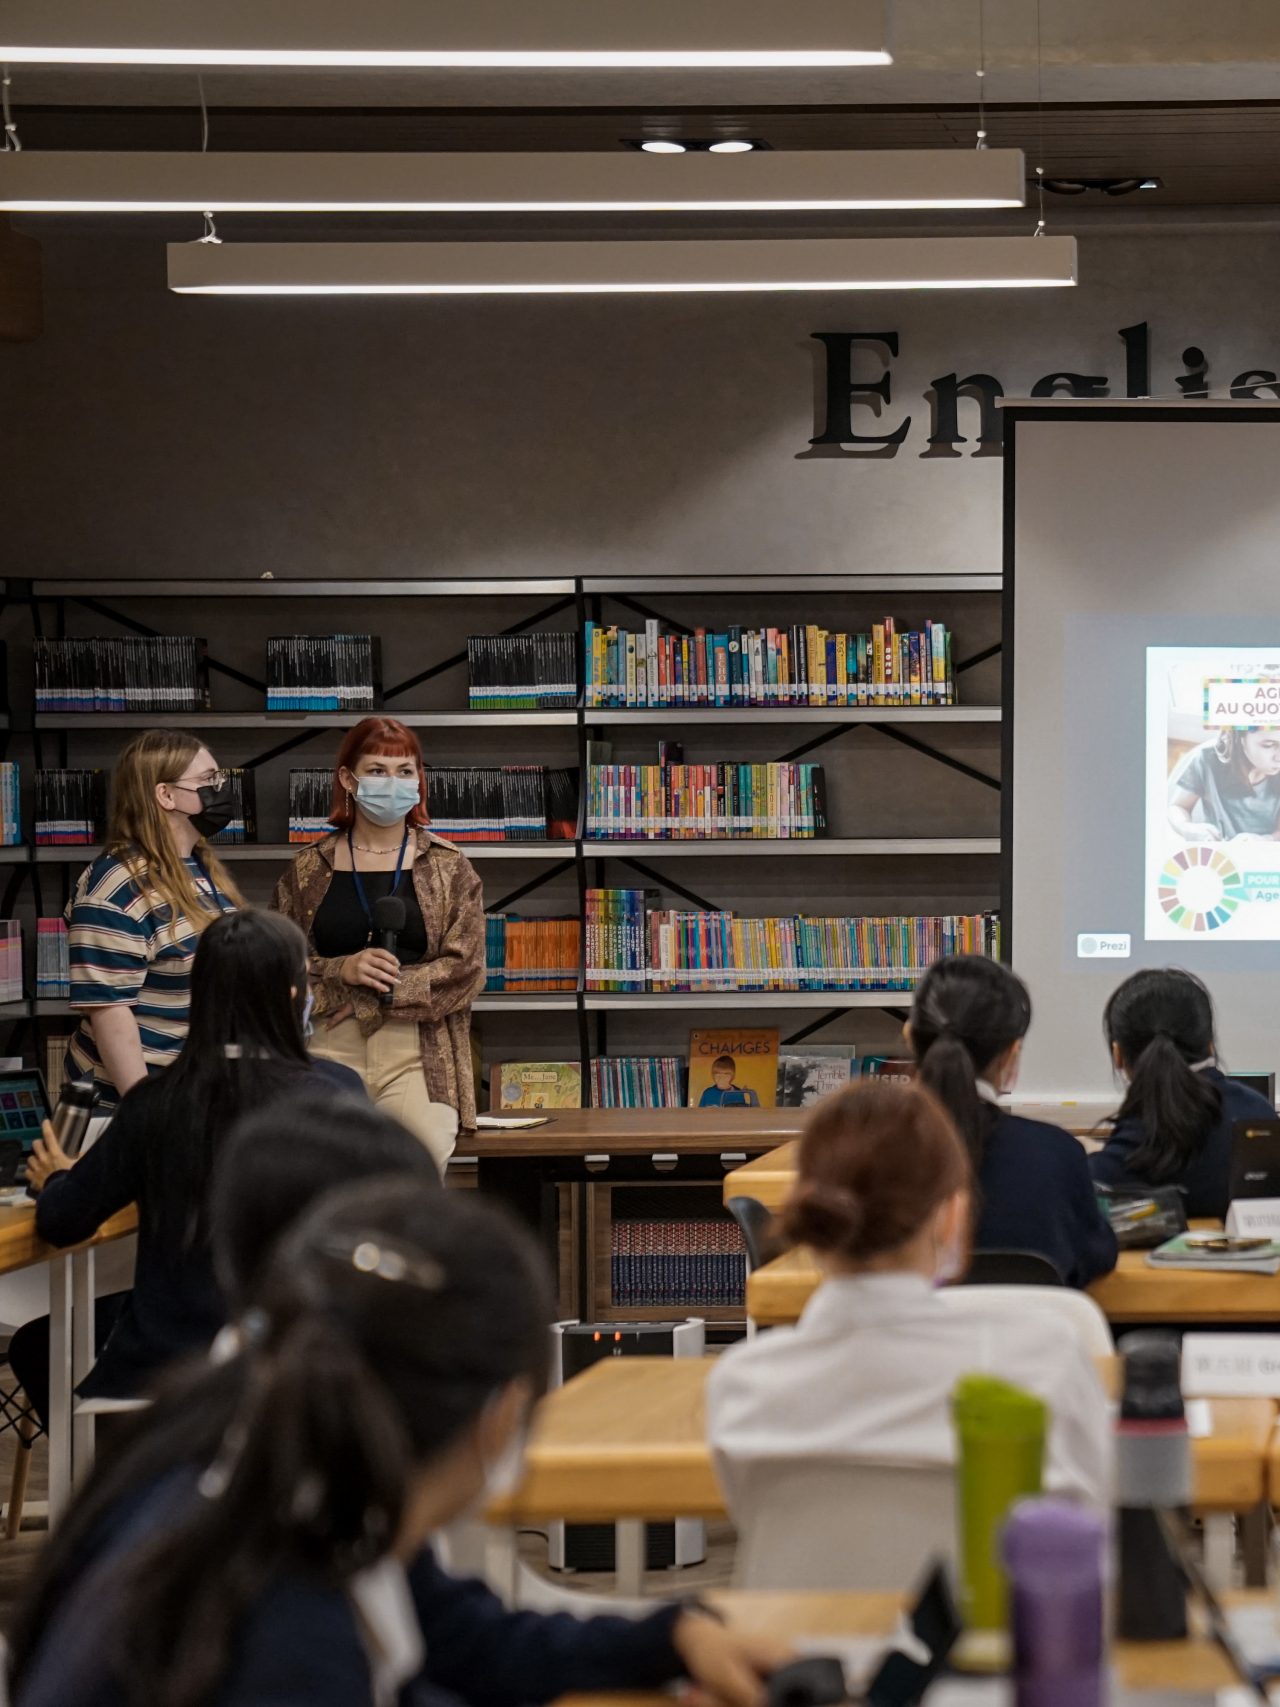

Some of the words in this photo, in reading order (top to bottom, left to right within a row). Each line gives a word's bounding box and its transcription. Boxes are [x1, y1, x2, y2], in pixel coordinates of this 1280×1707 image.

[1215, 702, 1239, 715] AU
[1247, 875, 1279, 886] POUR
[1100, 940, 1127, 950] Prezi
[698, 1040, 770, 1055] CHANGES
